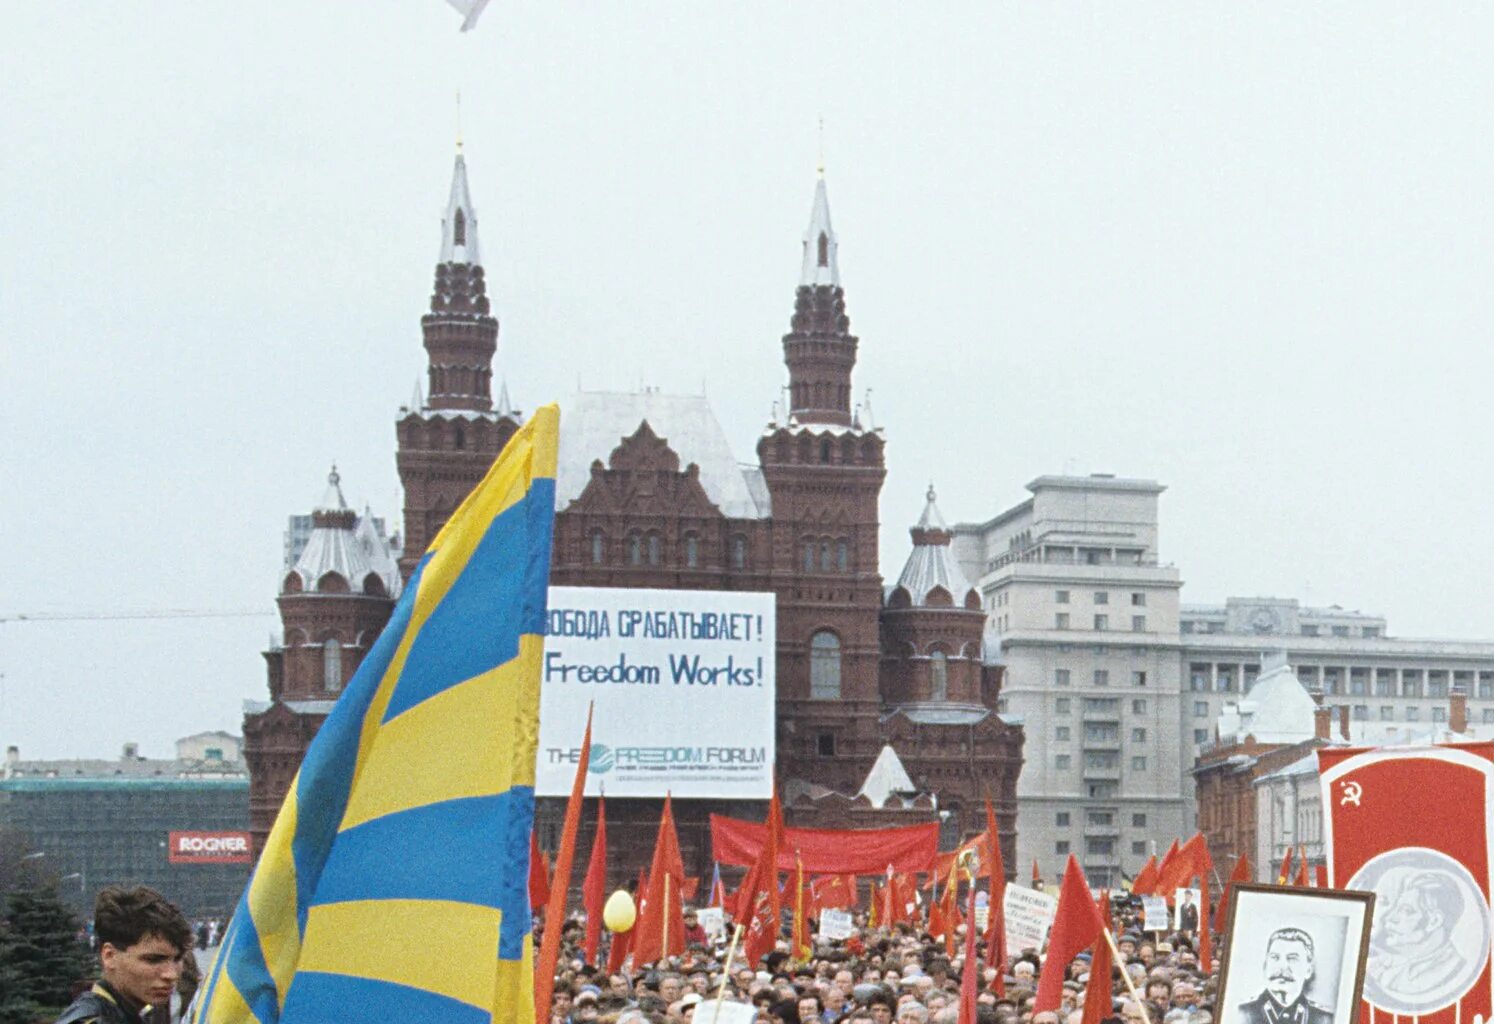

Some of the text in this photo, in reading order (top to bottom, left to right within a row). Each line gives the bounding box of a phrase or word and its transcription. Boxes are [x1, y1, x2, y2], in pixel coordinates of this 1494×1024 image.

[618, 609, 763, 642] СРАБАТЫВАЕТ!
[545, 652, 764, 687] Freedom Works!
[546, 747, 766, 763] THE FREEDOM FORUM
